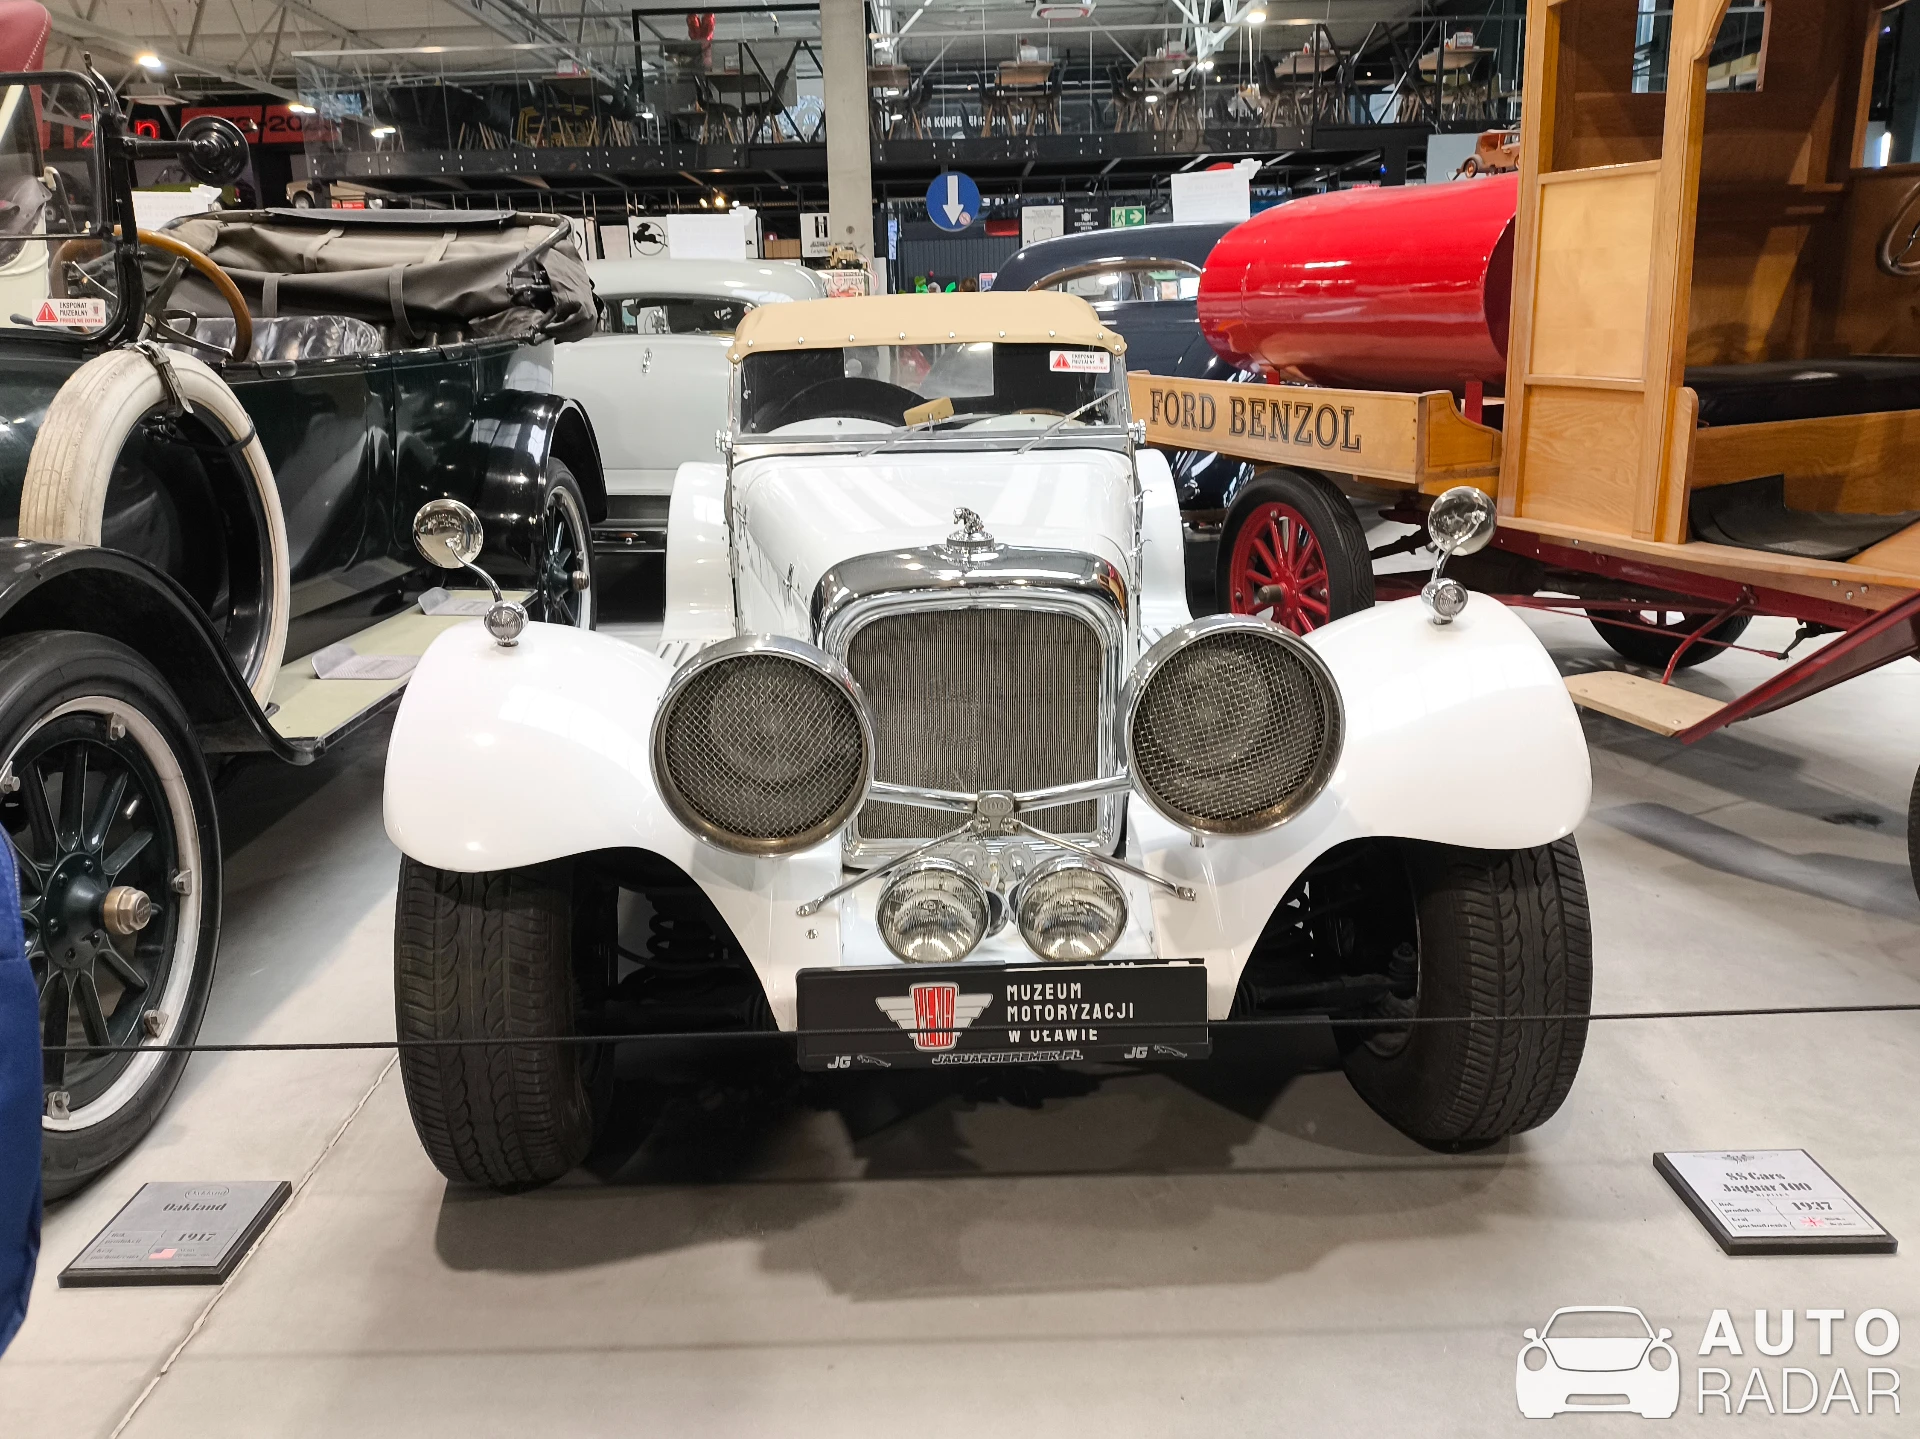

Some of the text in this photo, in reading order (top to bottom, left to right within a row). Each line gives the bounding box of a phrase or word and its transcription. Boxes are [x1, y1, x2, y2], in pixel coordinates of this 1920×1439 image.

[1149, 388, 1362, 454] FORD BENZOL
[1006, 982, 1082, 1001] MUZEUM
[1006, 1002, 1134, 1022] MOTORYZACJI
[1008, 1030, 1021, 1043] W
[1124, 1046, 1149, 1060] JG
[827, 1055, 852, 1069] JG
[1725, 1172, 1786, 1181] SS Cars
[1722, 1182, 1813, 1194] Jaguar 100
[162, 1203, 228, 1212] Oakland
[1791, 1201, 1833, 1211] 1937
[177, 1232, 217, 1242] 1917
